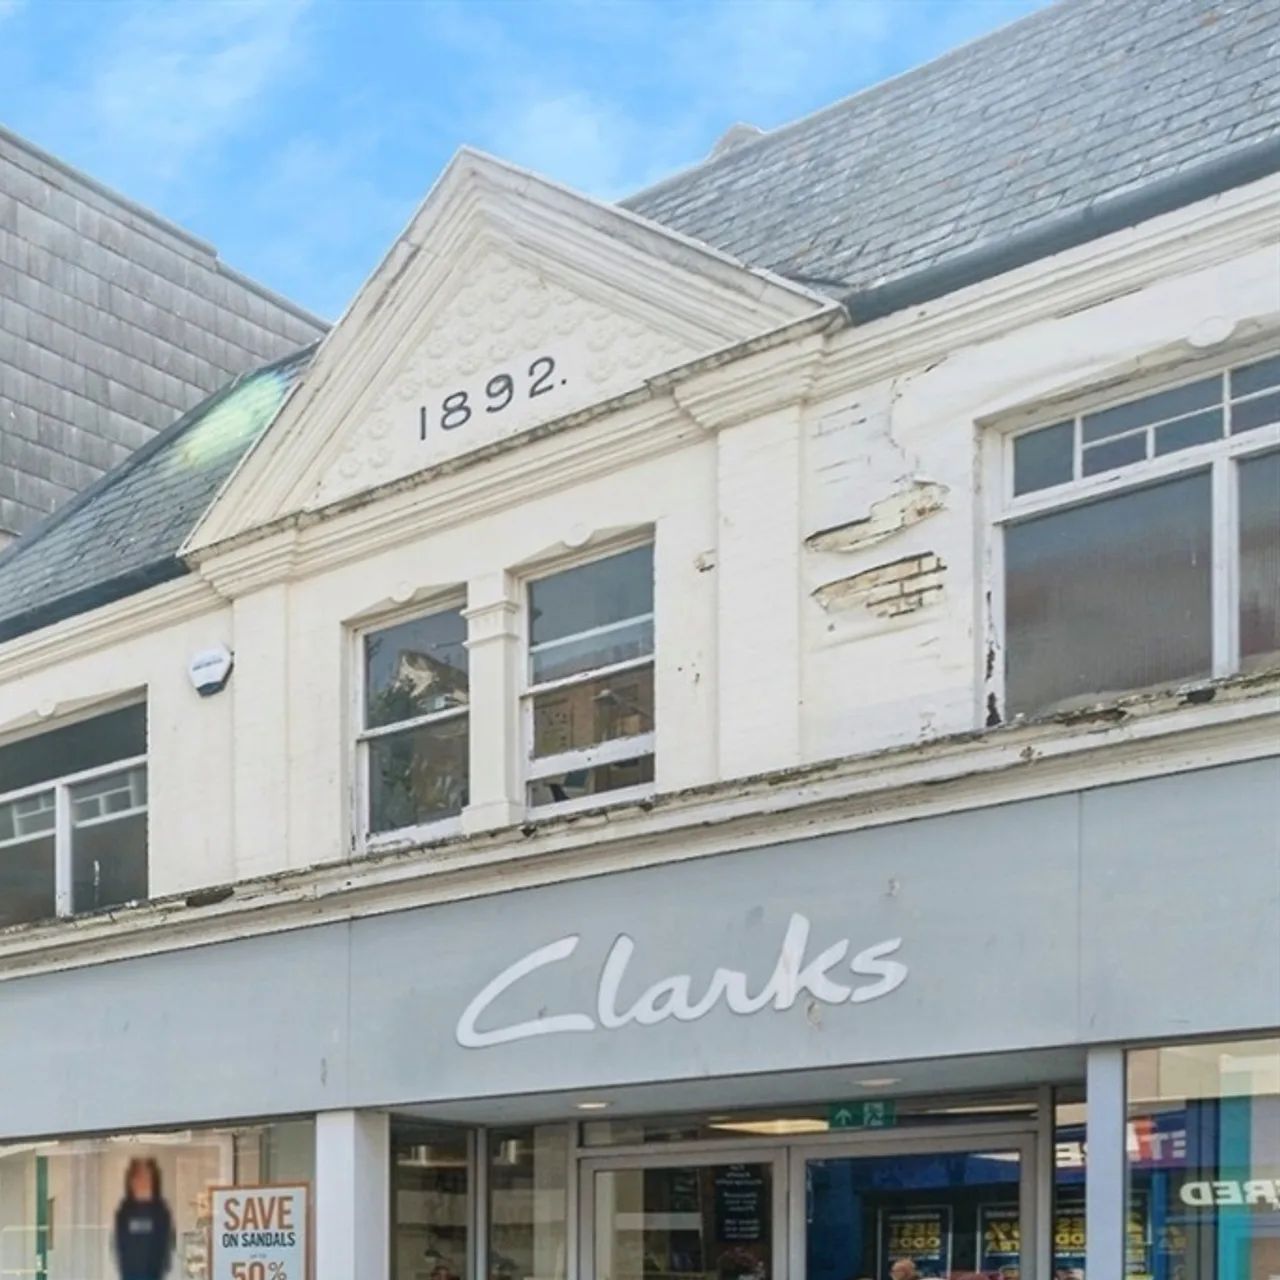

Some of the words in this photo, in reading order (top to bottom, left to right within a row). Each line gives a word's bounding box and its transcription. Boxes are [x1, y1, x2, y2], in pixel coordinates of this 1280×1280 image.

[455, 911, 910, 1049] Clarks
[224, 1196, 295, 1231] SAVE
[222, 1234, 239, 1248] ON
[241, 1232, 296, 1248] SANDALS
